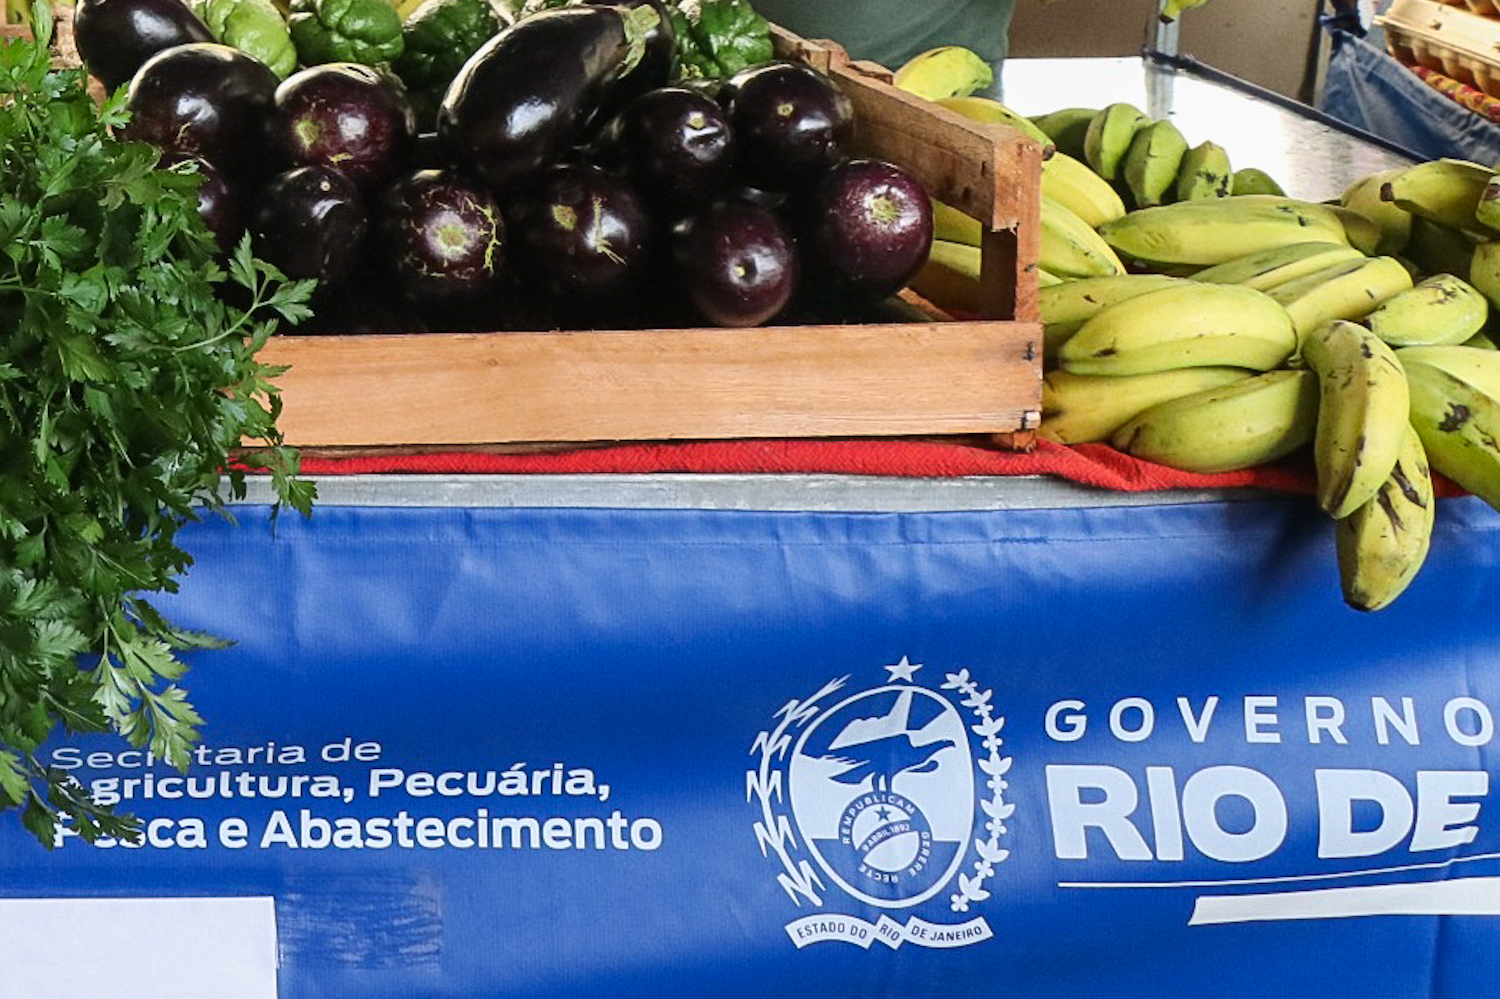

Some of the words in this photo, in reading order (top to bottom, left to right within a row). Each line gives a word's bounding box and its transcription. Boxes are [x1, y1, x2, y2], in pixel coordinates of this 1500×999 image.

[1045, 695, 1494, 747] GOVERNO
[321, 738, 381, 762] de
[60, 772, 355, 806] gricultura,
[369, 763, 611, 801] Pecuária,
[219, 817, 248, 848] e
[260, 808, 663, 850] Abastecimento
[842, 795, 915, 844] REMPUBLICAM
[1045, 764, 1288, 863] RIO
[1314, 768, 1490, 859] DE
[797, 921, 845, 939] ESTADO
[850, 924, 868, 940] DO
[879, 923, 901, 942] RIO
[911, 924, 927, 939] DE
[929, 925, 983, 942] JANEIRO
